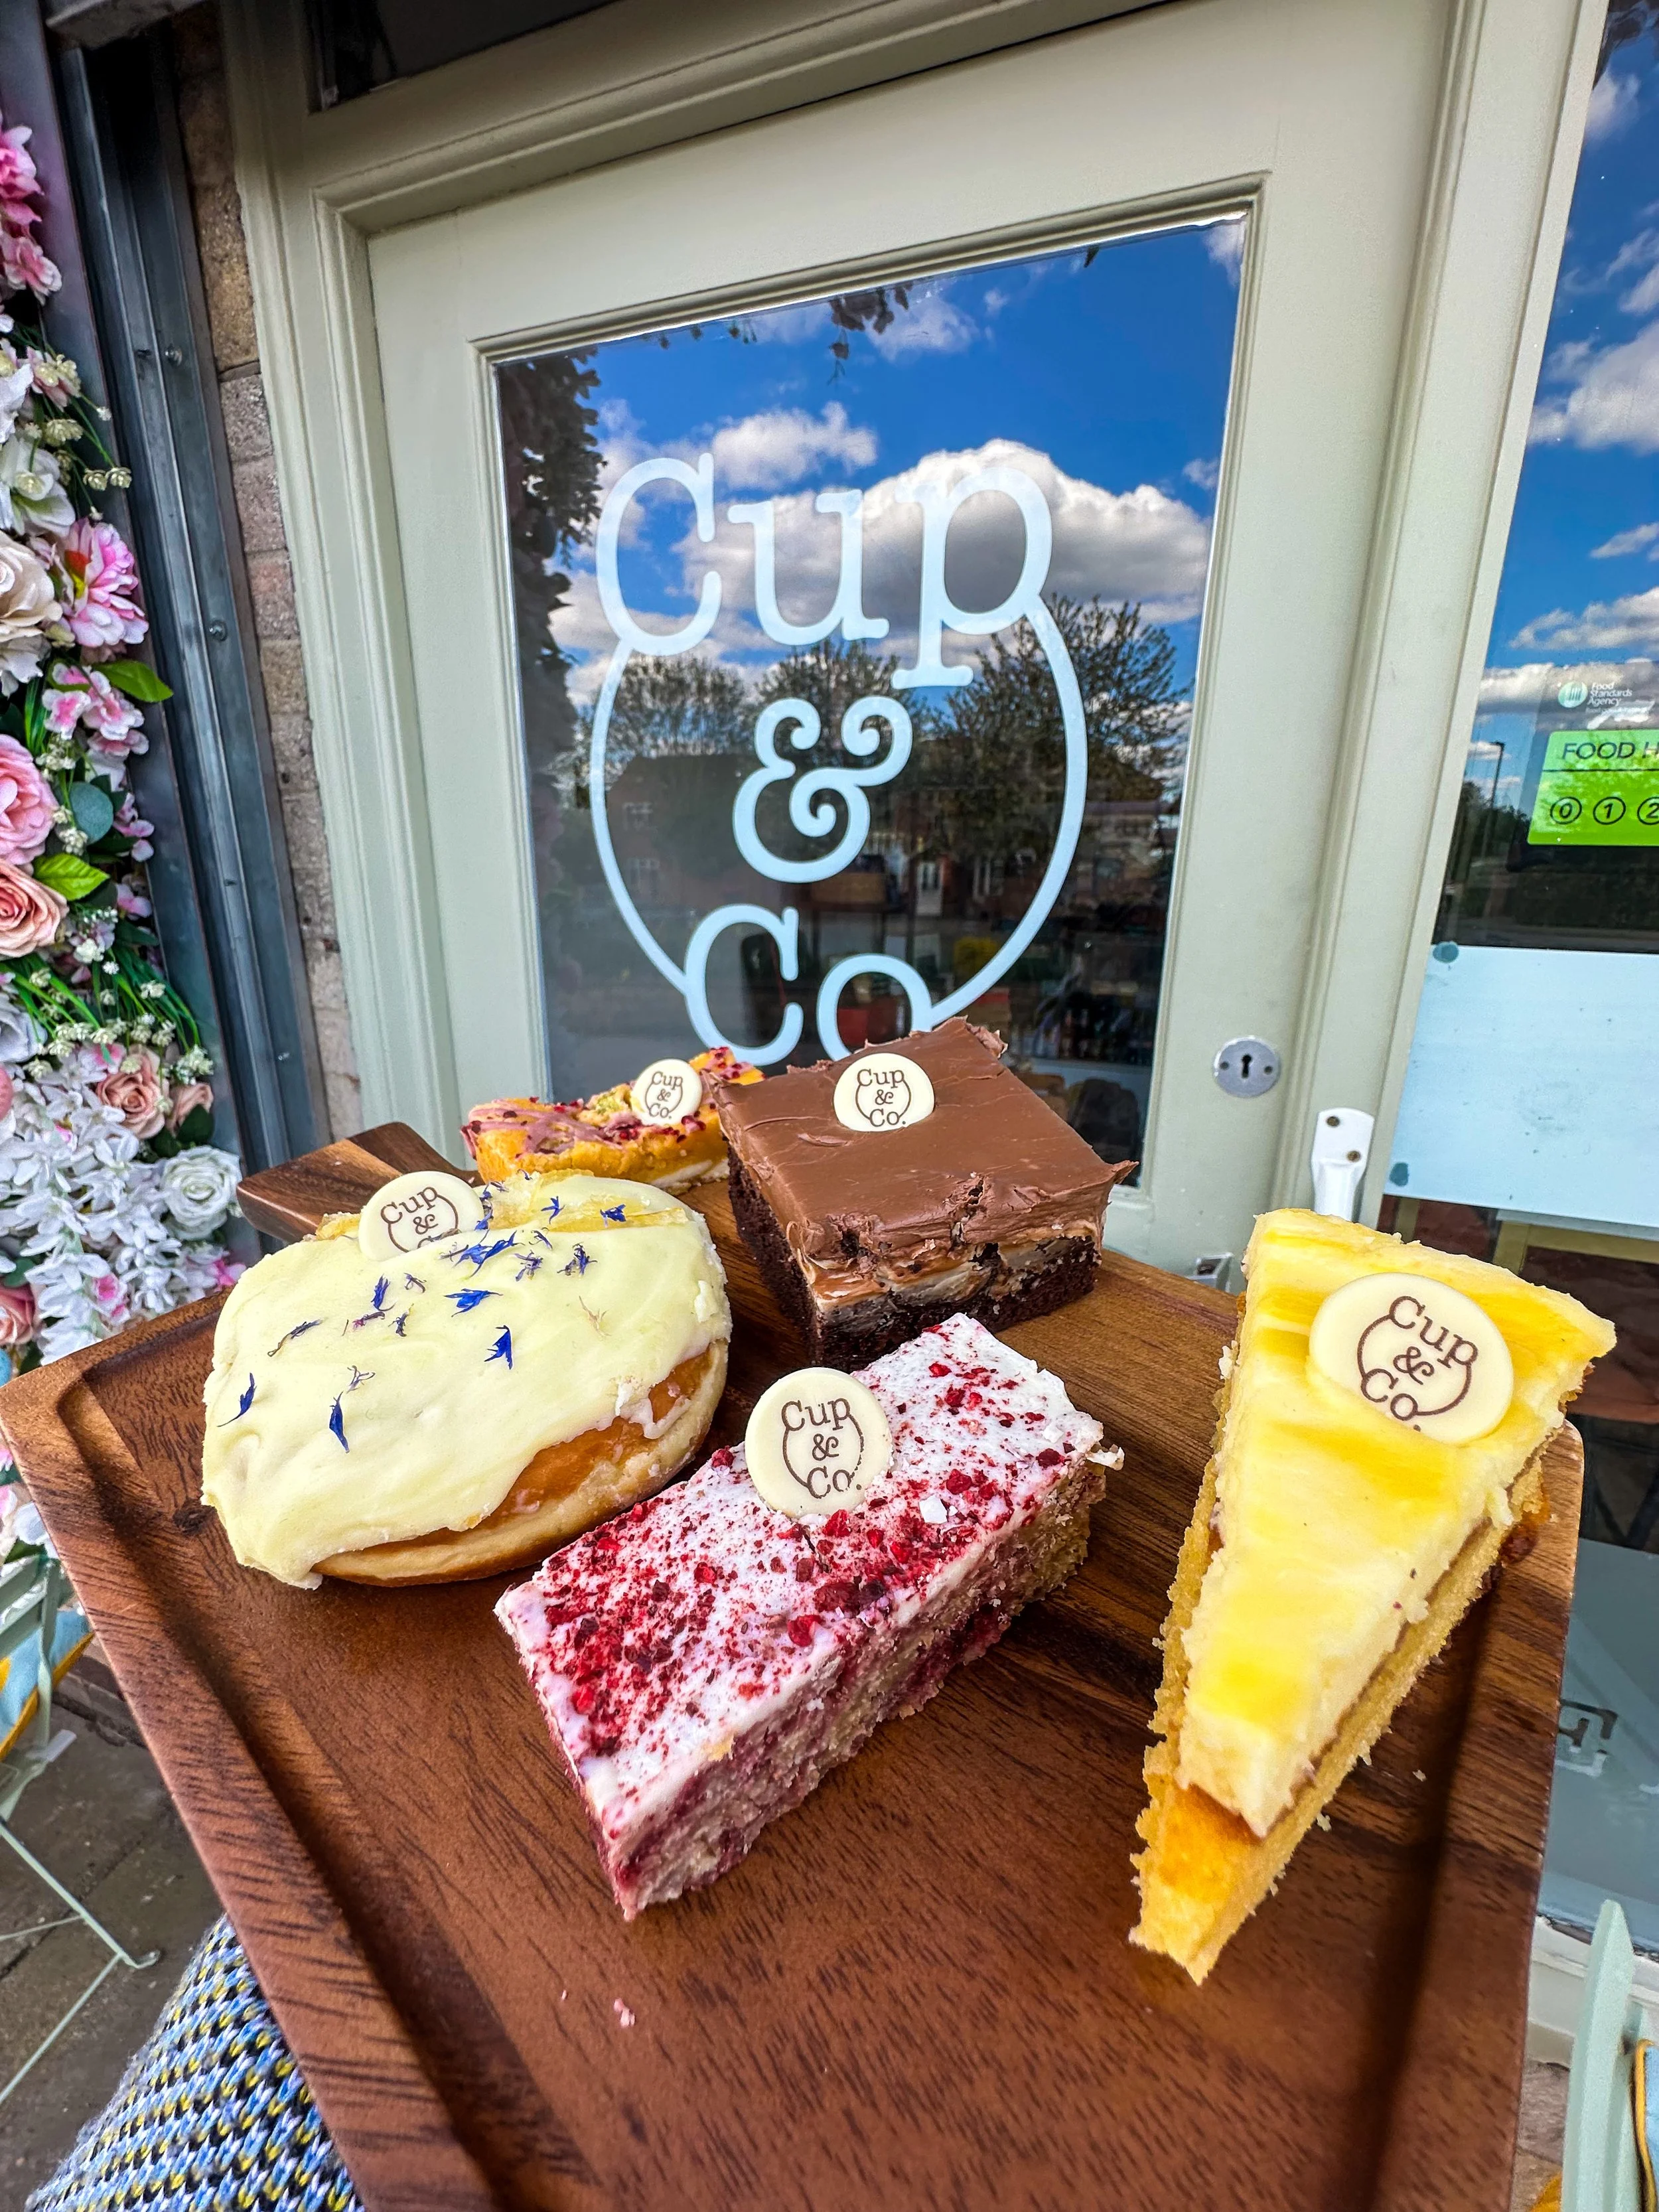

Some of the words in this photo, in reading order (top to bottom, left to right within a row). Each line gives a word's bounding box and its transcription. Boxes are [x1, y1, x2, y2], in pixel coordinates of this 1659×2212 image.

[595, 453, 1054, 688] Cup
[1589, 689, 1632, 698] Standards
[1592, 682, 1615, 690] Food
[1587, 698, 1622, 707] Agency
[1563, 742, 1636, 759] FOOD
[732, 696, 913, 884] &
[652, 1071, 684, 1090] Cup
[857, 1069, 904, 1088] Cup
[657, 1088, 671, 1102] &
[875, 1089, 894, 1105] &
[649, 1103, 672, 1119] Co.
[869, 1108, 906, 1127] Co.
[380, 1187, 439, 1224] Cup
[413, 1214, 439, 1234] &
[1389, 1295, 1479, 1368] Cup
[1393, 1346, 1435, 1385] &
[1360, 1368, 1421, 1432] Co.
[781, 1398, 851, 1432] Cup
[812, 1434, 839, 1461] &
[807, 1465, 862, 1499] Co.
